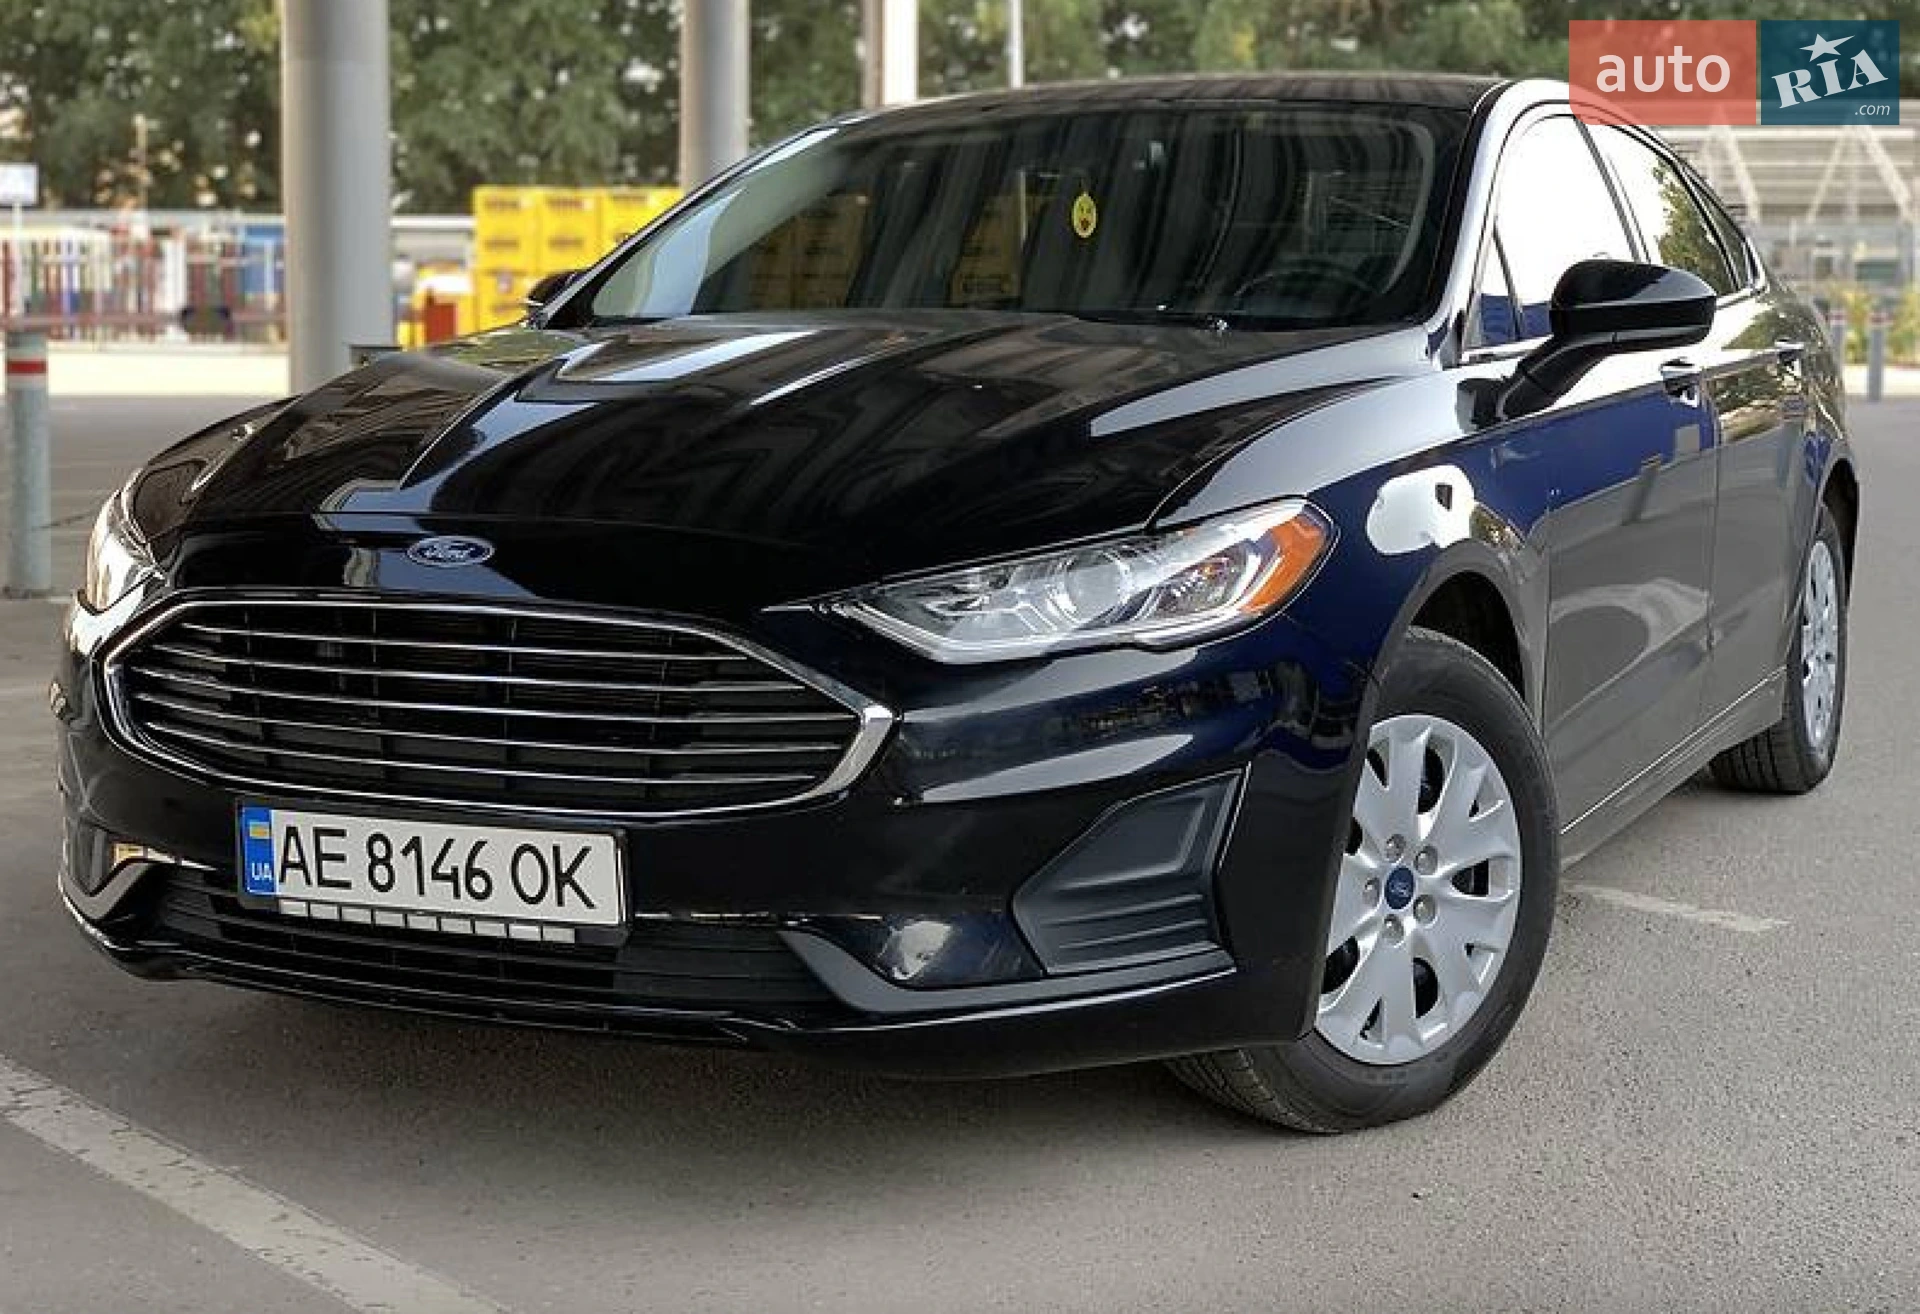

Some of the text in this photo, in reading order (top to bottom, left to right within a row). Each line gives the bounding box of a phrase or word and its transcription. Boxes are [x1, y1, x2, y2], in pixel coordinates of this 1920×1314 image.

[251, 862, 272, 882] UA
[278, 825, 597, 910] AE 8146 OK
